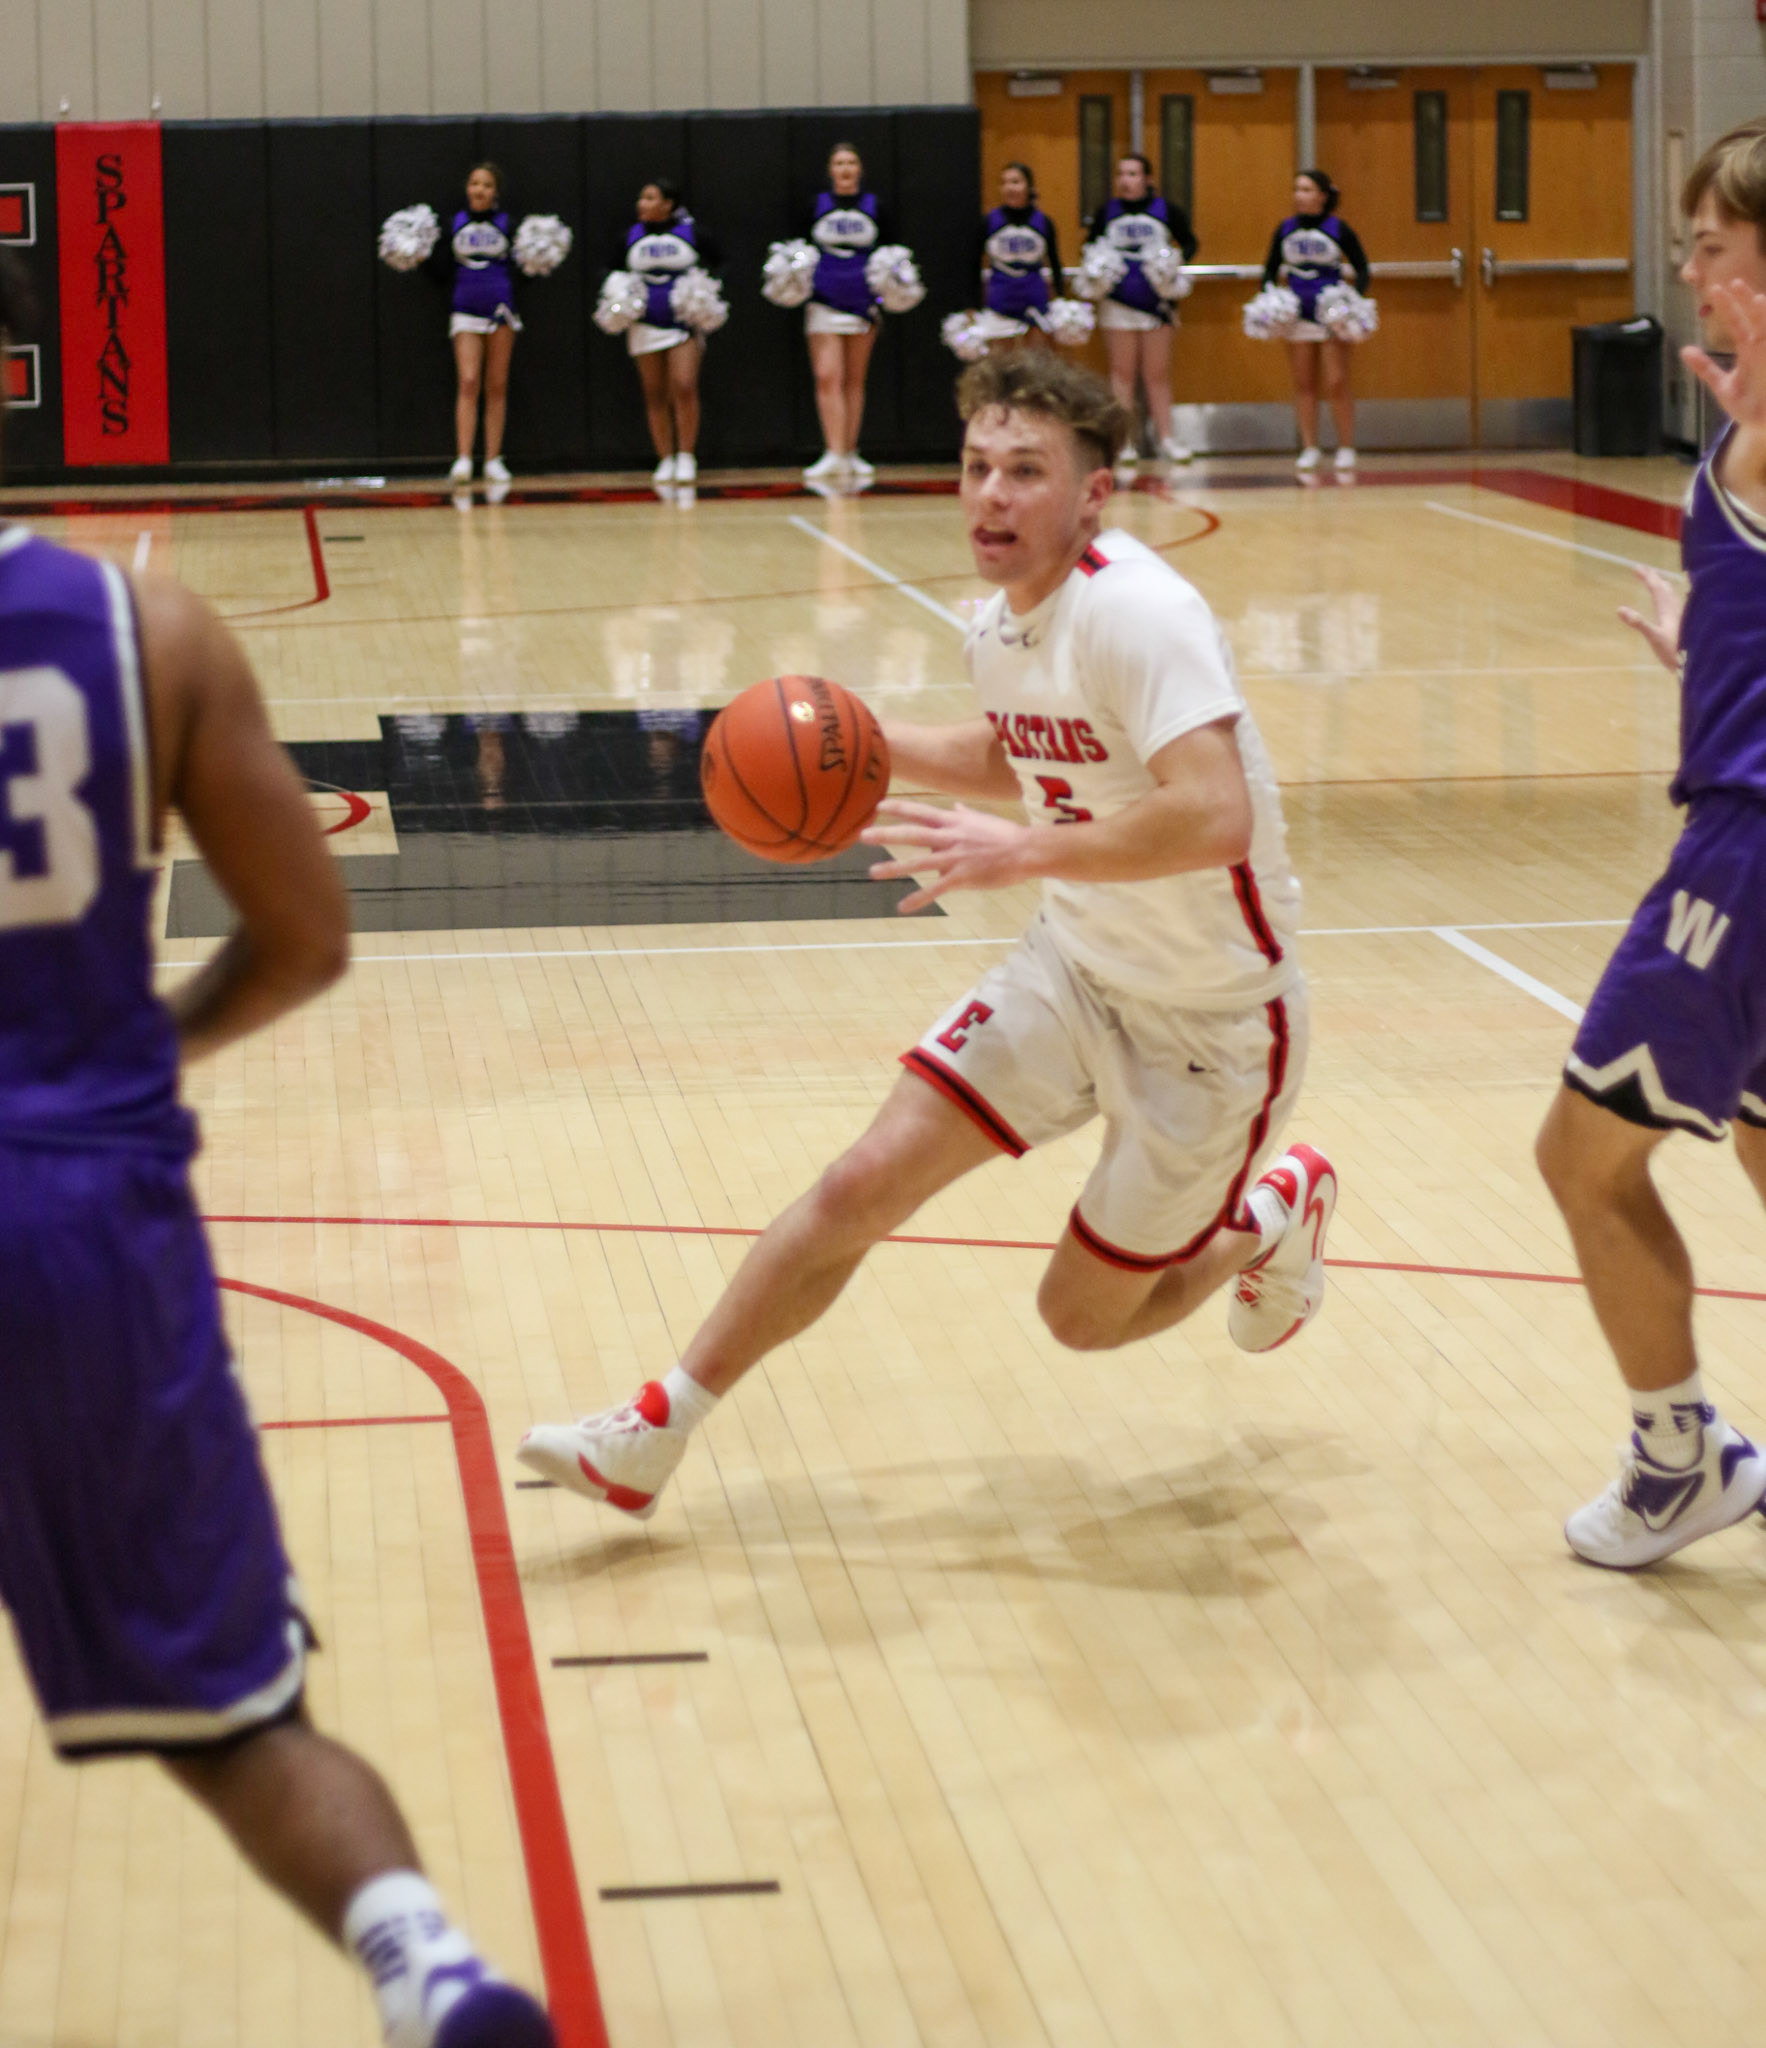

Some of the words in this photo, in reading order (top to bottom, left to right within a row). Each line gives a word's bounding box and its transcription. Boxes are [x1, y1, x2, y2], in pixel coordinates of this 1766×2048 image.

[94, 153, 131, 437] SPARTANS
[1664, 889, 1731, 970] W
[935, 999, 994, 1053] E
